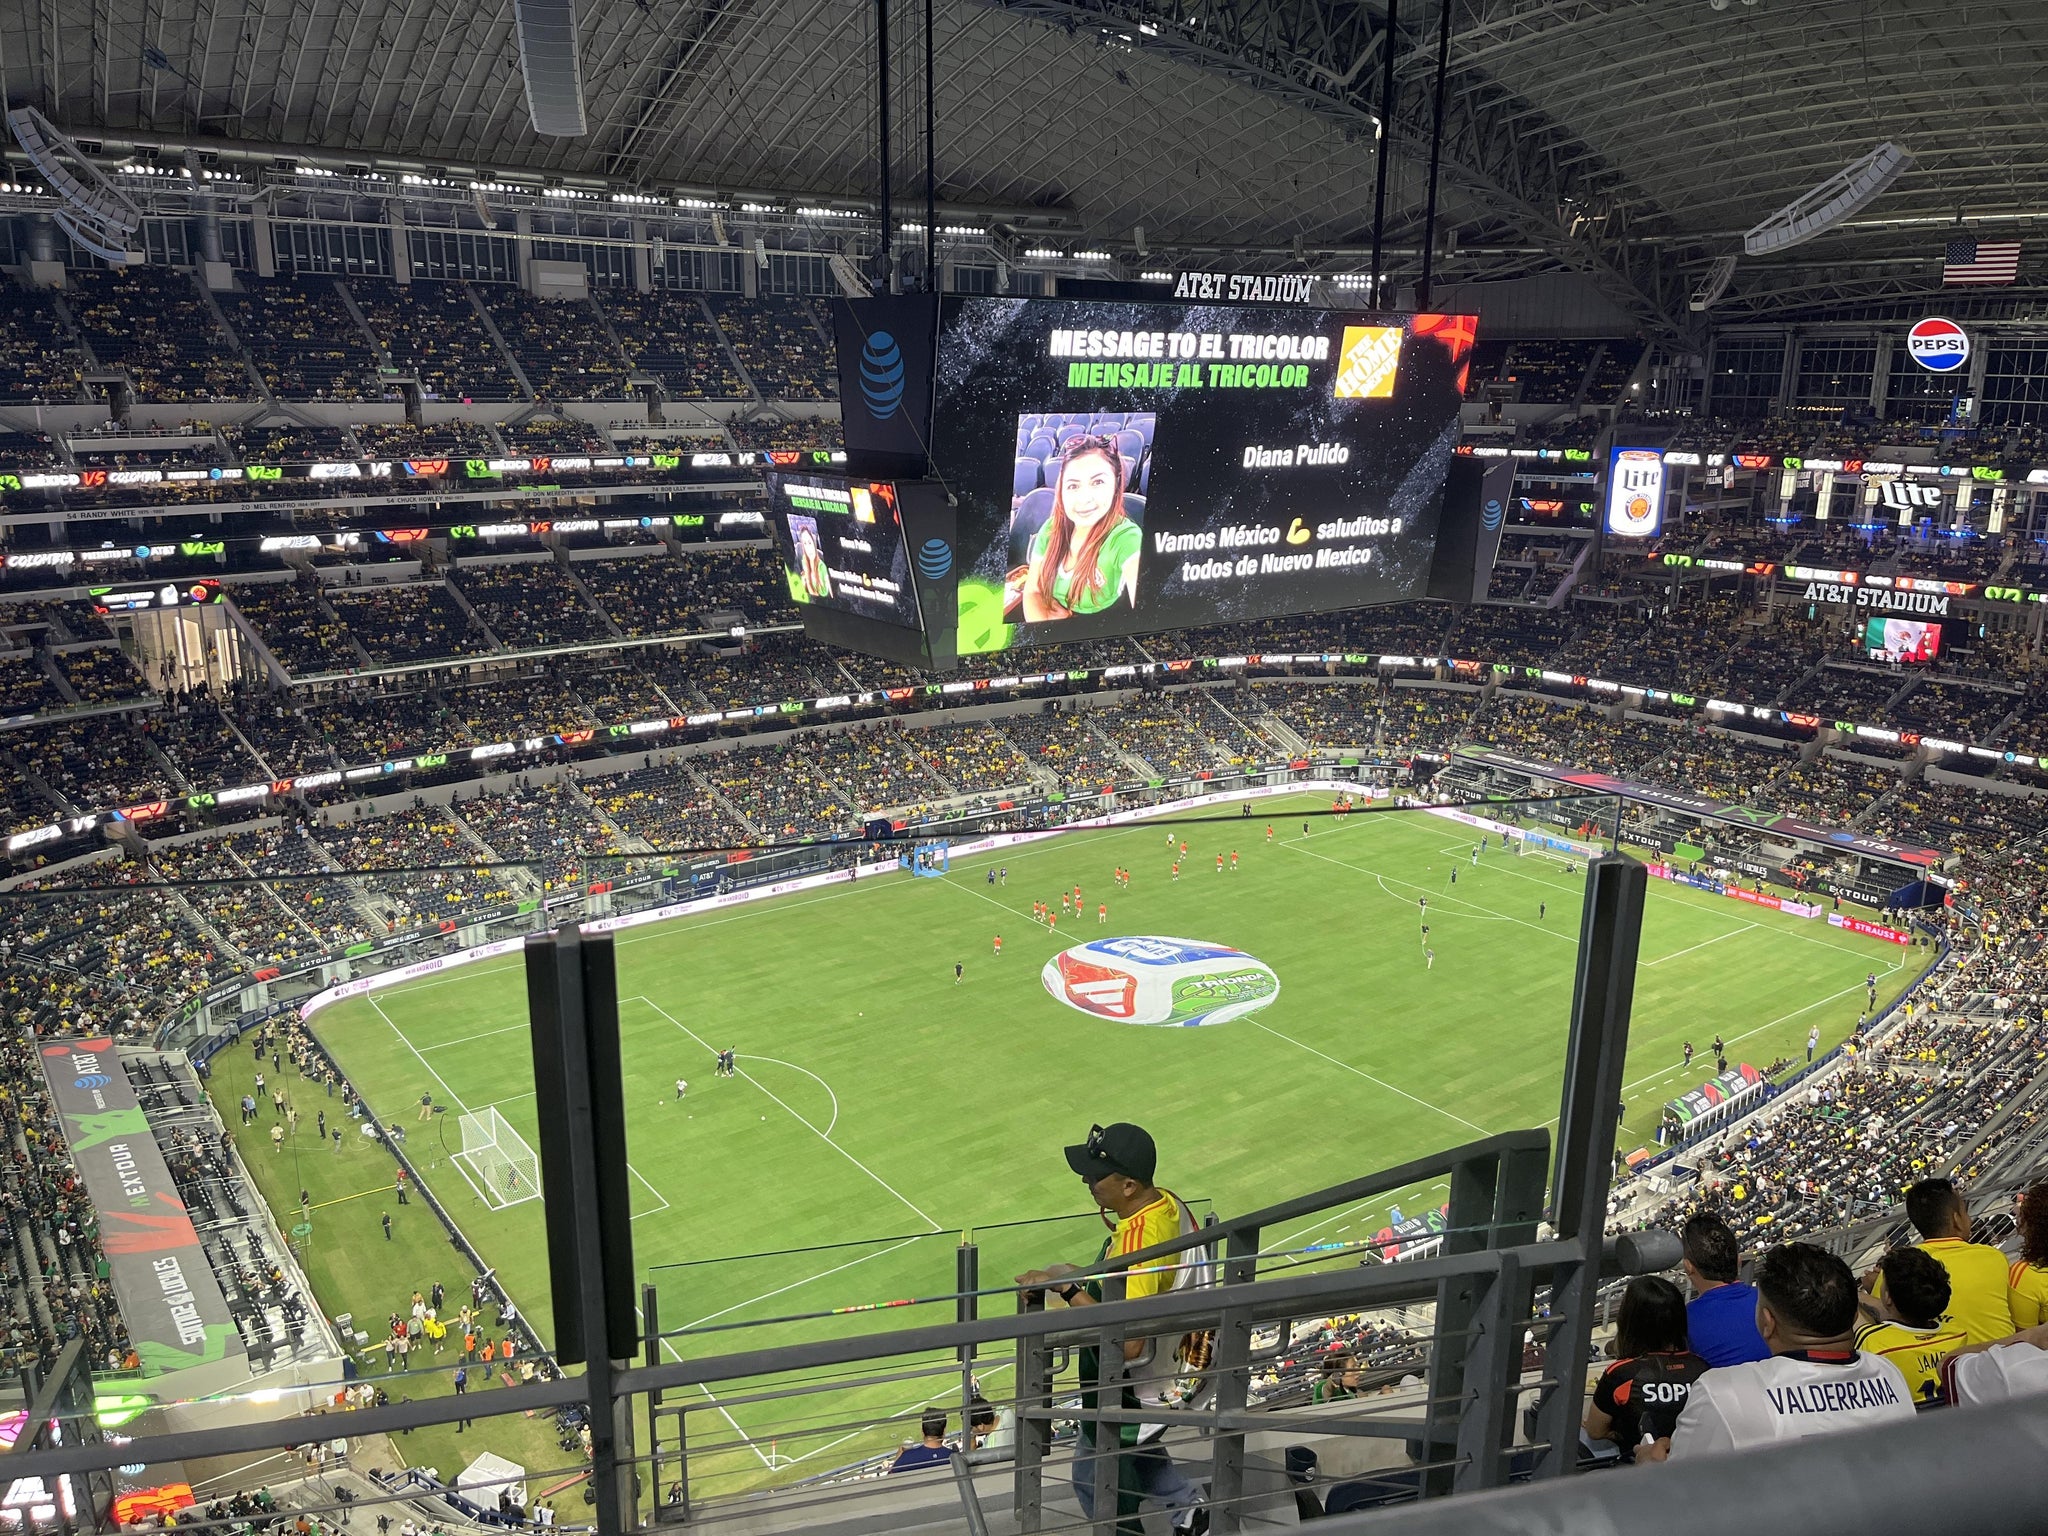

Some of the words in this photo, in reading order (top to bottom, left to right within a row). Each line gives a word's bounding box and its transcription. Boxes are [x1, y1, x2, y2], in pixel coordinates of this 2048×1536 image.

[1174, 272, 1224, 299] AT&T
[1228, 274, 1313, 303] STADIUM
[1050, 329, 1165, 358] MESSAGE
[1167, 332, 1196, 358] TO
[1199, 333, 1226, 359] EL
[1229, 334, 1330, 360] TRICOLOR
[1346, 334, 1374, 361] THE
[1912, 339, 1964, 351] PEPSI
[1335, 327, 1403, 398] HOME
[1067, 362, 1175, 388] MENSAJE
[1176, 364, 1203, 388] AL
[1208, 365, 1309, 388] TRICOLOR
[738, 452, 756, 465] VS
[1243, 445, 1292, 468] Diana
[1296, 443, 1349, 466] Pulido
[1706, 454, 1724, 466] VS
[370, 462, 392, 476] VS
[532, 458, 550, 470] VS
[1844, 460, 1862, 472] VS
[83, 471, 107, 486] VS
[108, 470, 163, 484] COLOMBIA
[1623, 469, 1659, 491] Lite
[1877, 480, 1942, 510] Lite
[67, 512, 77, 520] 54
[80, 511, 107, 519] RANDY
[531, 521, 550, 533] VS
[335, 533, 360, 546] VS
[1155, 531, 1216, 553] Vamos
[1219, 524, 1280, 547] México
[1316, 517, 1389, 540] saluditos
[1391, 518, 1402, 534] a
[151, 546, 176, 555] AT&T
[7, 552, 75, 568] COLOMBIA
[1182, 558, 1233, 582] todos
[1235, 554, 1258, 577] de
[1261, 552, 1313, 575] Nuevo
[1315, 545, 1371, 568] Mexico
[1804, 582, 1853, 604] AT&T
[1856, 586, 1949, 615] STADIUM
[1248, 655, 1260, 664] VS
[1422, 657, 1438, 667] VS
[1142, 663, 1155, 673] VS
[975, 679, 989, 690] VS
[1573, 676, 1587, 686] VS
[858, 692, 874, 704] VS
[1753, 707, 1771, 718] VS
[670, 717, 687, 728] VS
[525, 738, 543, 750] VS
[1901, 733, 1919, 745] VS
[272, 779, 292, 794] VS
[1454, 787, 1482, 801] XTOUR
[71, 815, 97, 832] VS
[1624, 832, 1662, 848] XTOUR
[1853, 839, 1903, 853] AT&T
[699, 872, 714, 881] AT&T
[1818, 883, 1879, 904] MEXTOUR
[1855, 921, 1895, 940] STRAUSS
[1189, 973, 1265, 989] TRIONDA
[72, 1052, 103, 1075] AT&T
[109, 1142, 151, 1208] MEXTOUR
[152, 1255, 188, 1291] LOCALES
[171, 1302, 208, 1346] SOMOS
[1767, 1377, 1899, 1416] VALDERRAMA
